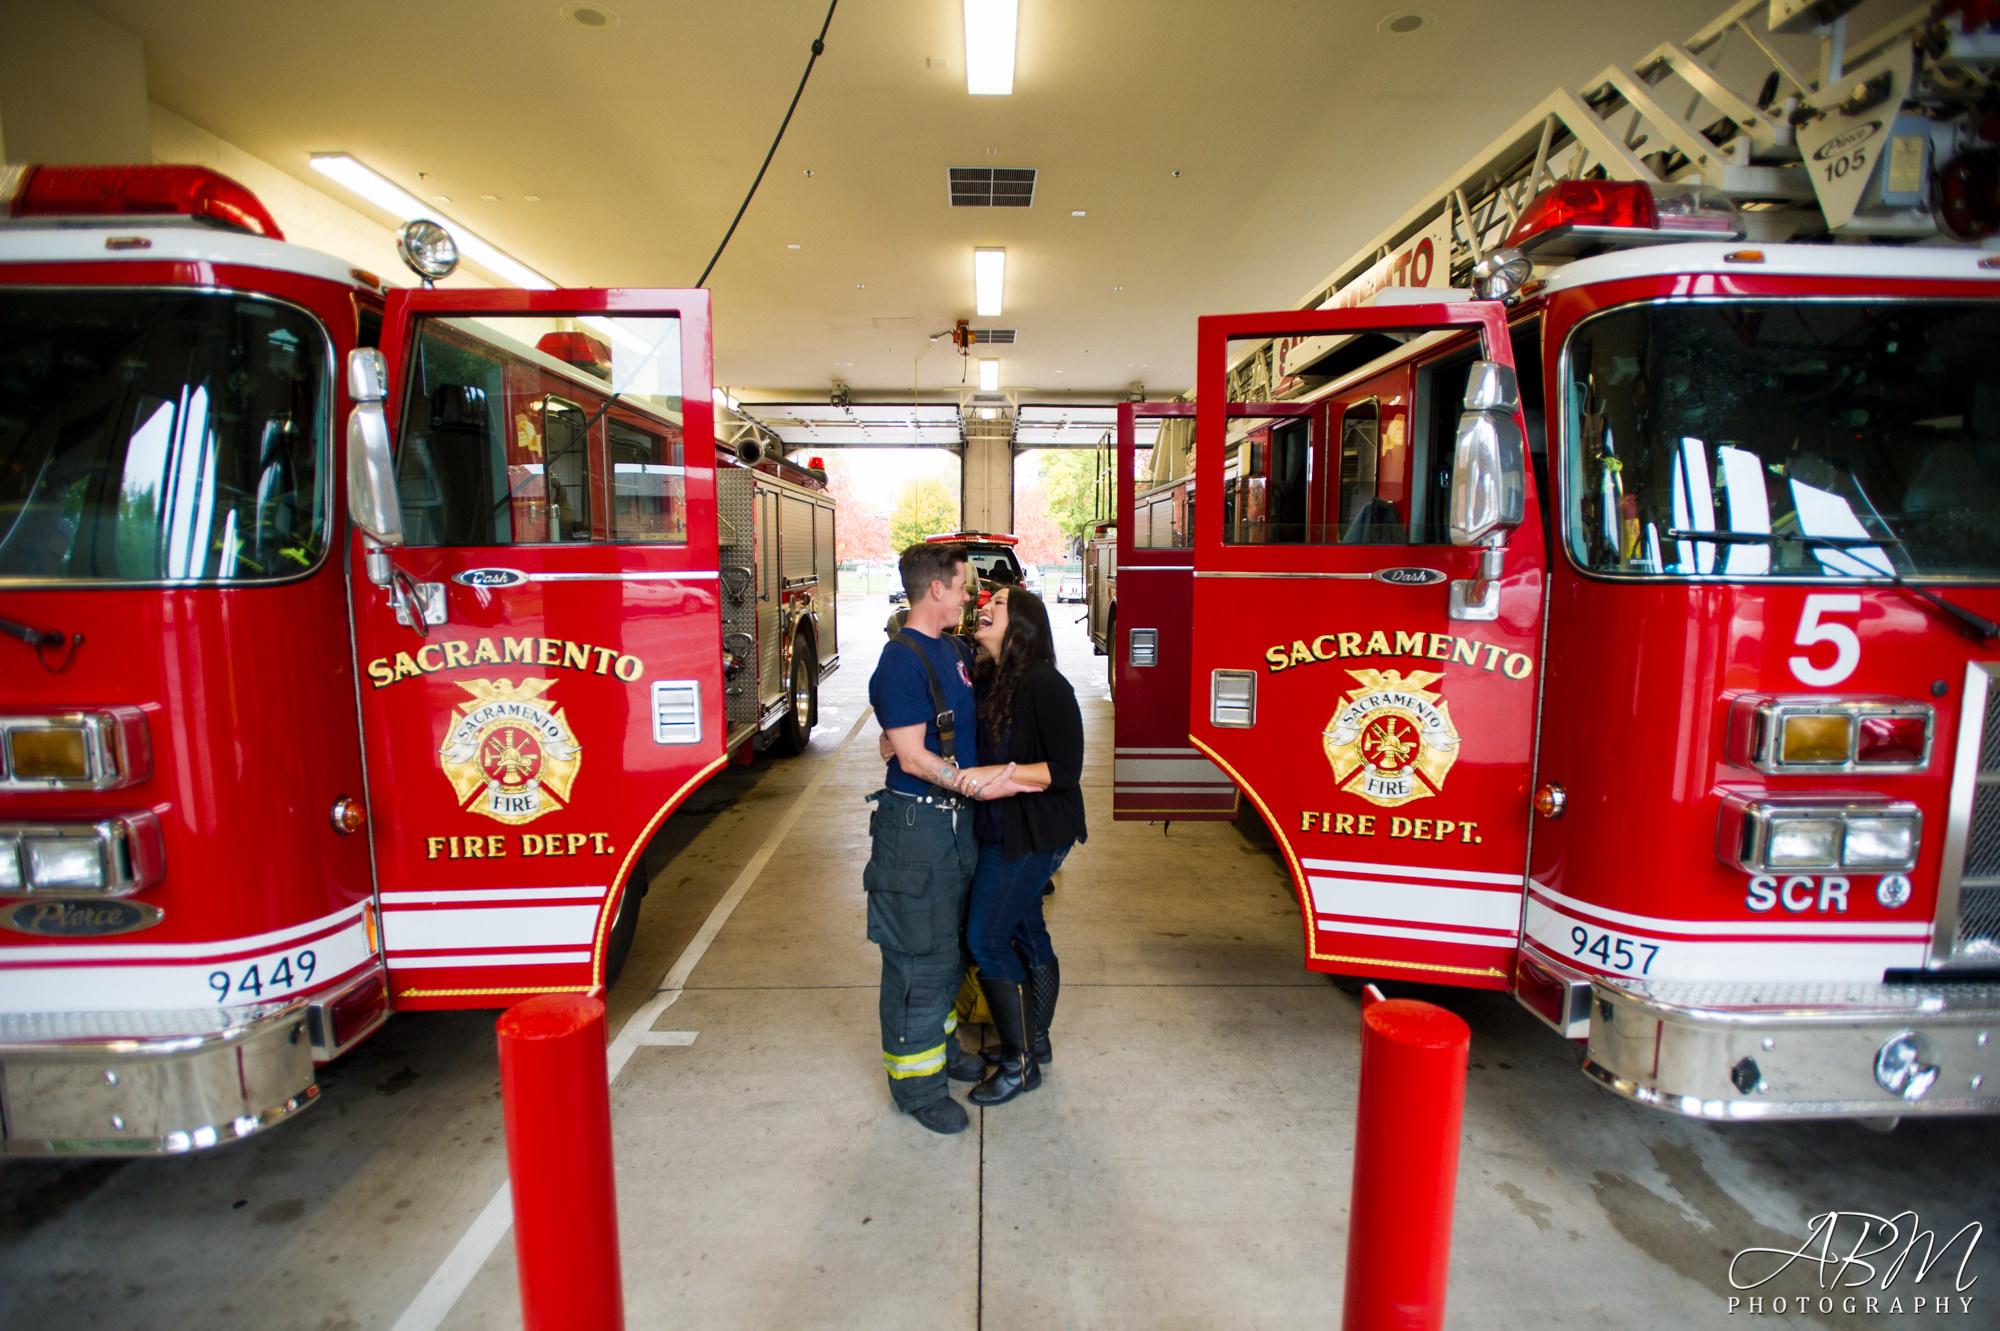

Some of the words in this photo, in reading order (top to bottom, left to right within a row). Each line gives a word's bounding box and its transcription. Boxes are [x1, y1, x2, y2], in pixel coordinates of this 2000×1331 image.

[1825, 147, 1866, 182] 105
[472, 571, 509, 584] Dash
[1391, 569, 1427, 582] Dash
[1264, 630, 1533, 680] SACRAMENTO
[1788, 593, 1861, 687] 5
[366, 636, 644, 690] SACRAMENTO
[457, 704, 560, 739] SACRAMENTO
[1343, 693, 1442, 729] SACRAMENTO
[493, 794, 537, 812] FIRE
[1368, 778, 1410, 796] FIRE
[1300, 810, 1376, 837] FIRE
[1390, 816, 1483, 845] DEPT.
[426, 835, 506, 860] FIRE
[519, 832, 616, 857] DEPT.
[1745, 875, 1851, 914] SCR
[29, 901, 125, 932] Pierce
[1570, 925, 1660, 976] 9457
[208, 950, 317, 1004] 9449
